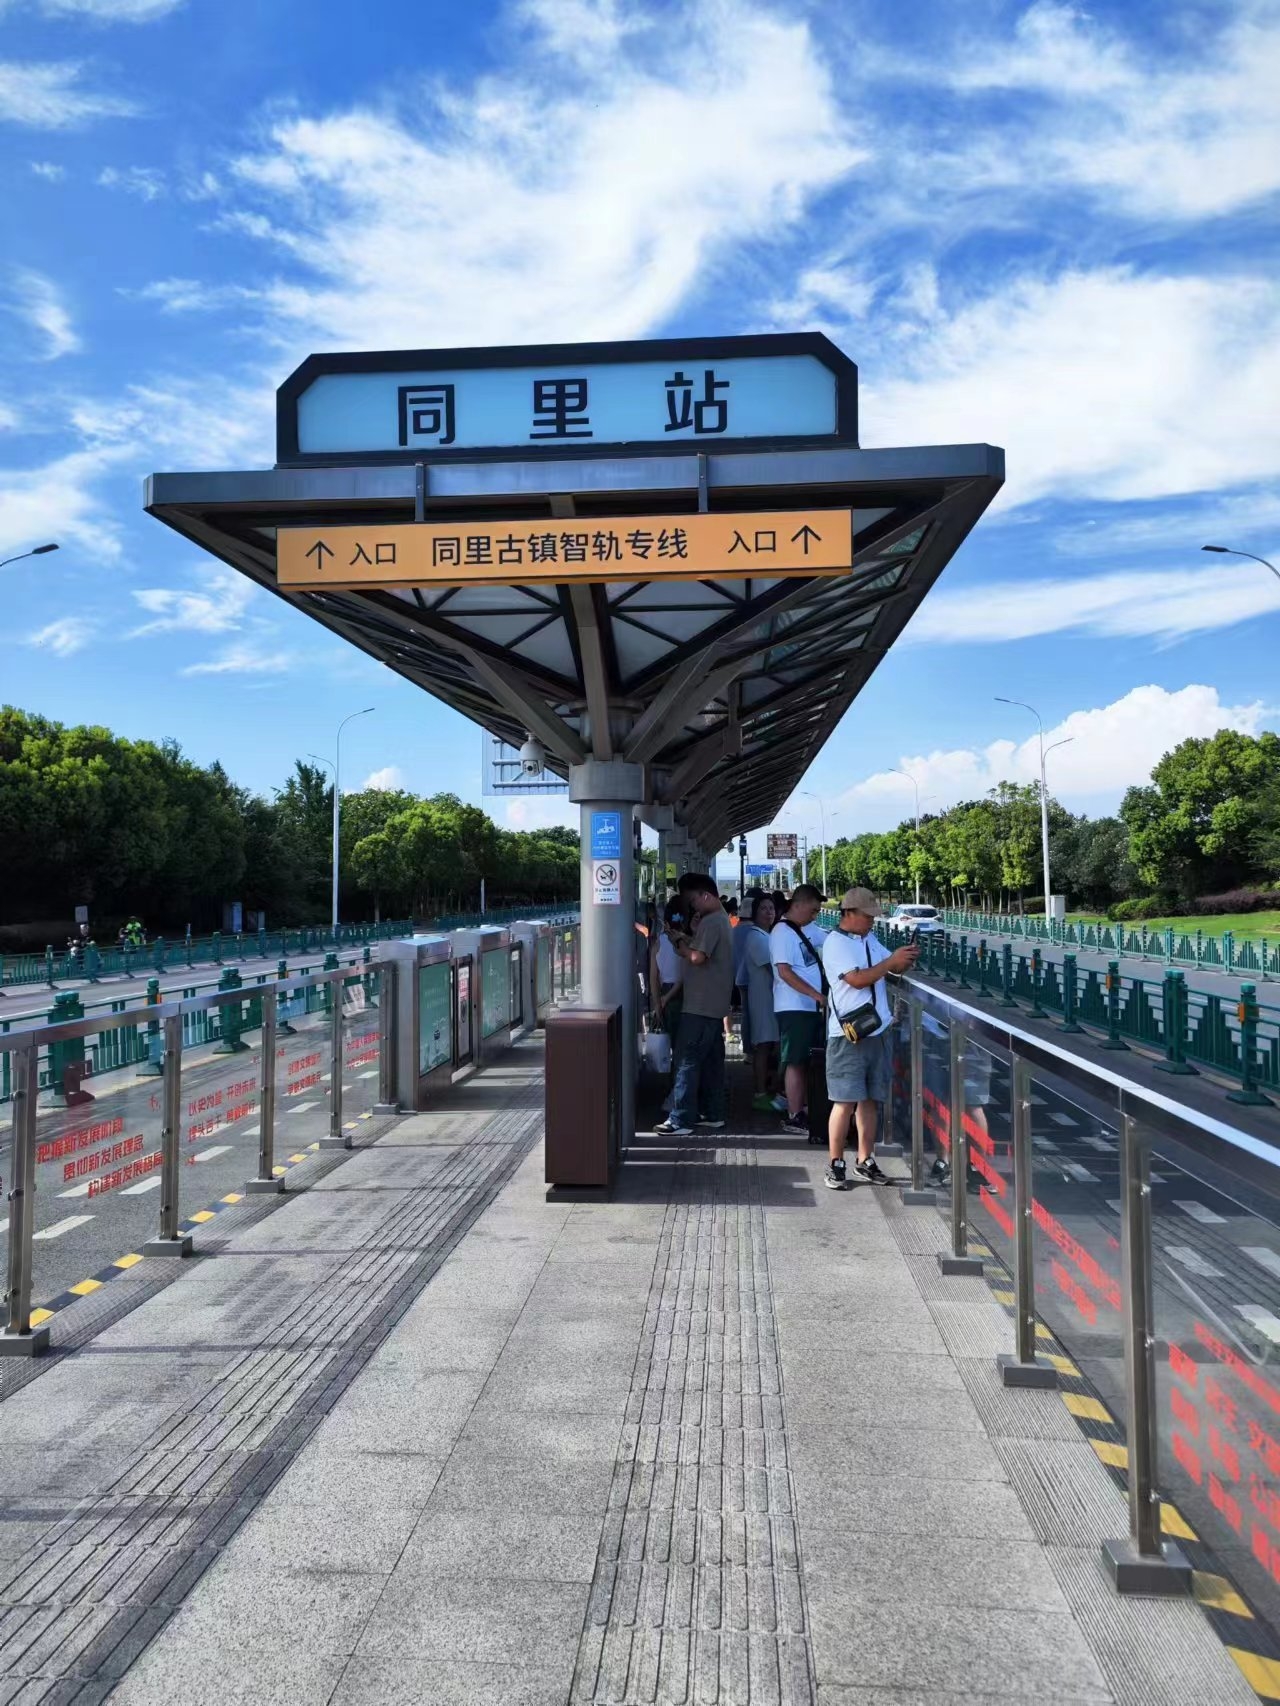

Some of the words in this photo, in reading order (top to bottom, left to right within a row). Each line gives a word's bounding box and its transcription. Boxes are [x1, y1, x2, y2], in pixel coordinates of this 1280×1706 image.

[396, 368, 731, 447] 同里站
[349, 541, 398, 566] 入口
[431, 527, 689, 567] 同里古镇智轨专线
[727, 529, 777, 555] 入口
[37, 1116, 125, 1165] 把握新发展阶段
[63, 1133, 145, 1183] 贯彻新发展理念
[87, 1150, 165, 1200] 构建新发展格局
